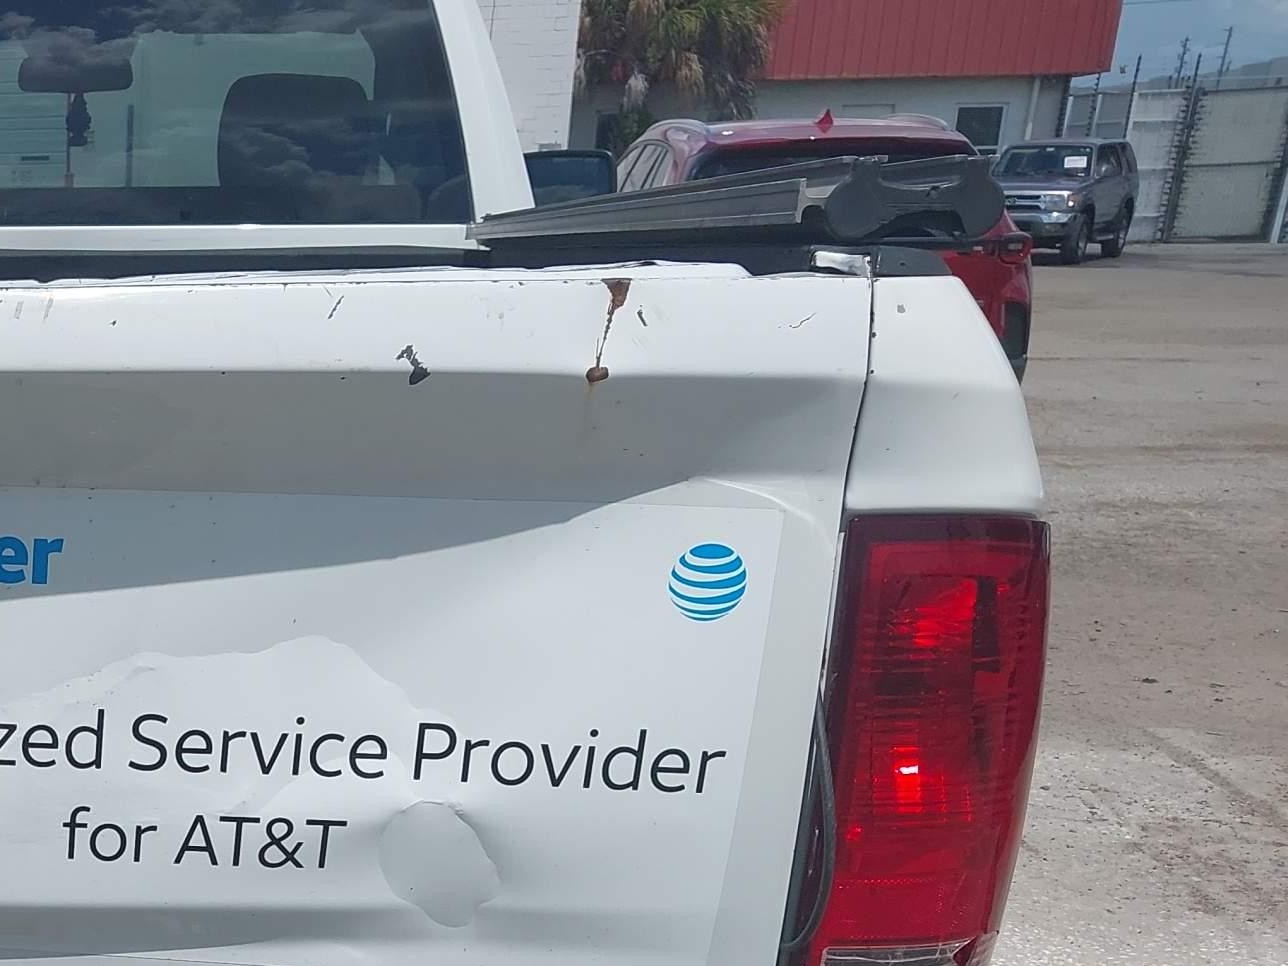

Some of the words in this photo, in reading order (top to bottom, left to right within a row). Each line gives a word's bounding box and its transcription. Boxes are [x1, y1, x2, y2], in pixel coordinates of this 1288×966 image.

[129, 714, 387, 778] Service
[414, 723, 726, 793] Provider
[63, 806, 157, 862] for
[174, 815, 347, 868] AT&T
